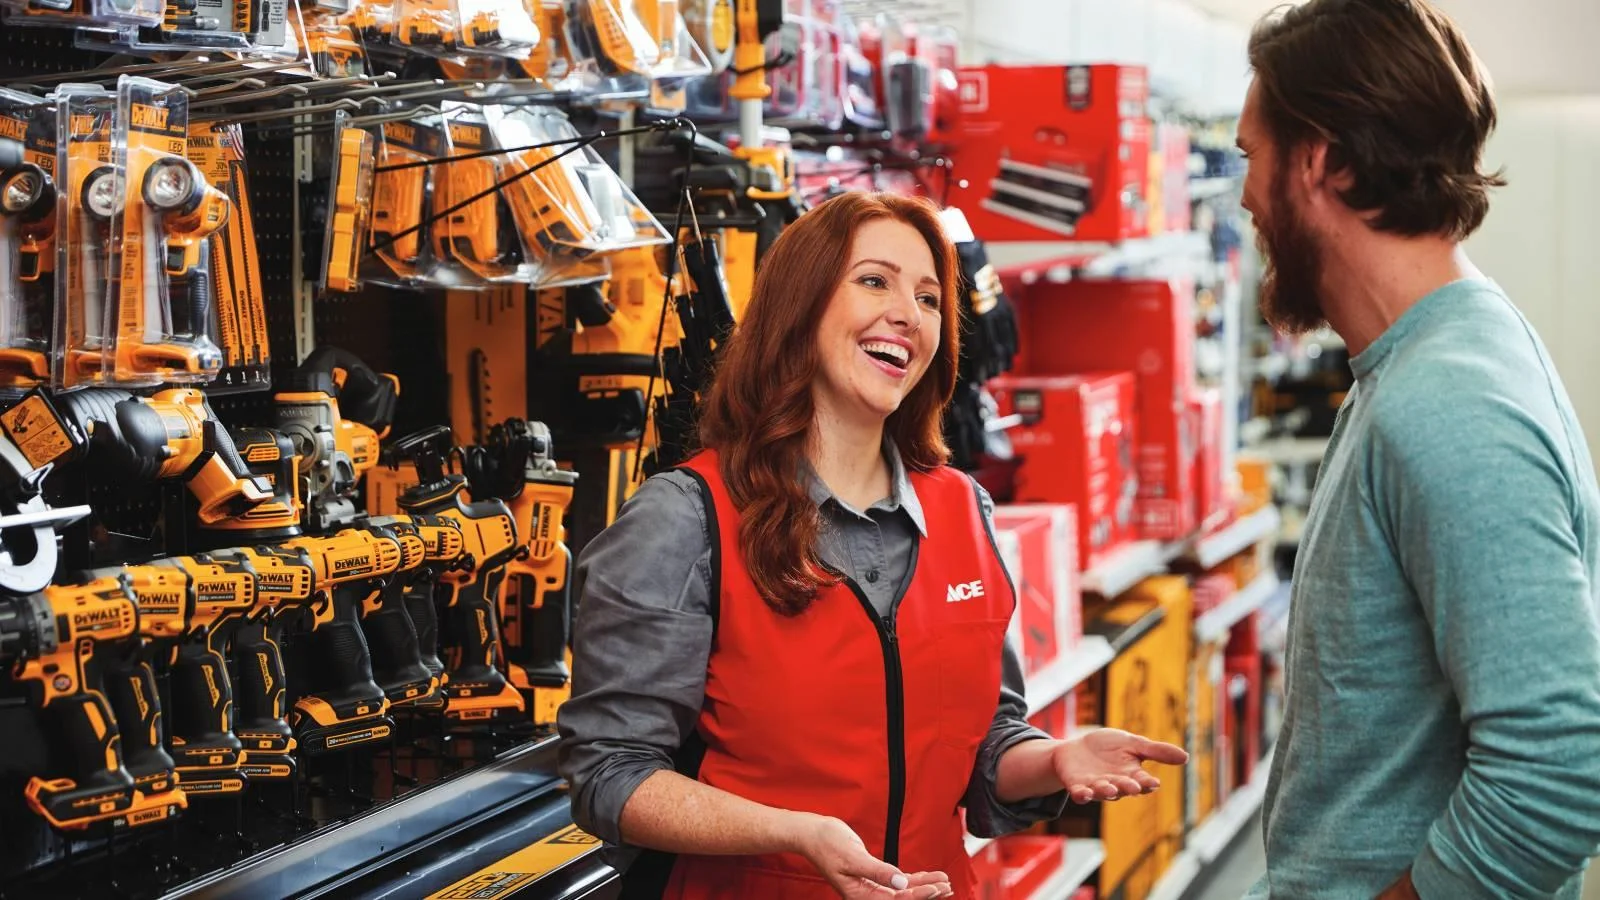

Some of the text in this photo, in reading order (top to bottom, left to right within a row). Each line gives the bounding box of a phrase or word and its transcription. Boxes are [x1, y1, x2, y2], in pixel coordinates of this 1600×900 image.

[131, 105, 168, 128] DEWALT
[168, 141, 183, 153] LED
[35, 154, 53, 167] LED
[242, 371, 246, 380] 1
[542, 506, 551, 538] DEWALT
[334, 556, 370, 570] DEWALT
[257, 574, 294, 583] DEWALT
[198, 582, 236, 592] DEWALT
[946, 579, 985, 602] ACE
[139, 593, 180, 605] DEWALT
[74, 608, 120, 625] DEWALT
[134, 811, 162, 822] DEWALT
